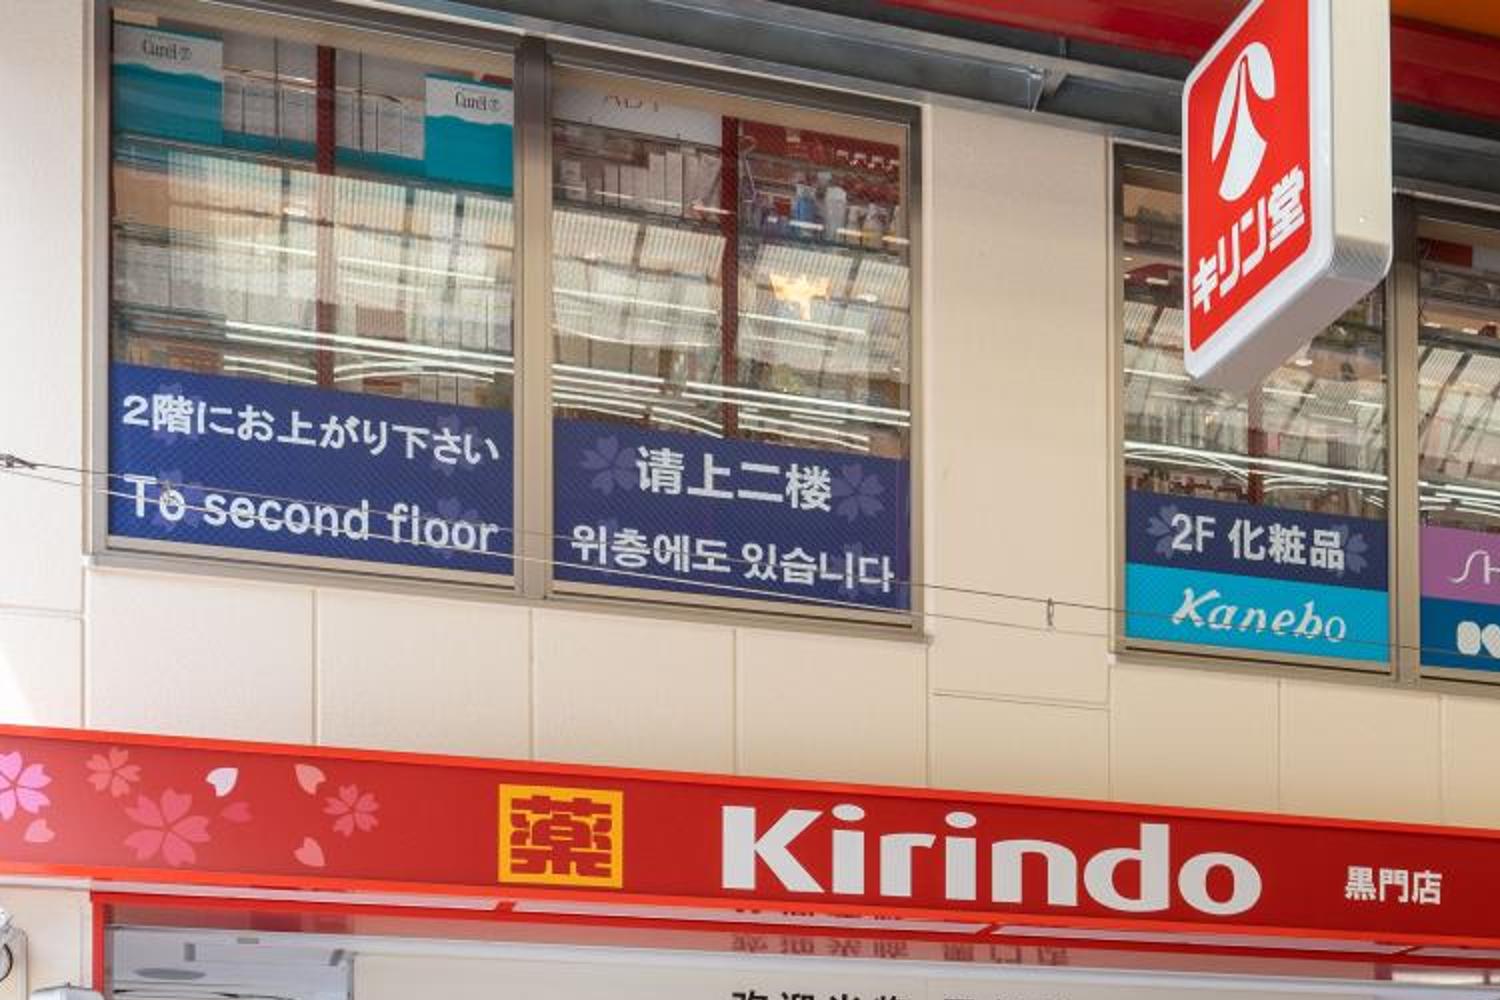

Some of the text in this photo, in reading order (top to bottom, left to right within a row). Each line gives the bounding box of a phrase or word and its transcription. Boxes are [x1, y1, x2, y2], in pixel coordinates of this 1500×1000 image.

[1191, 164, 1306, 313] キリン堂
[122, 394, 500, 466] 2階にお上がり下さい
[122, 474, 500, 553] To second floor
[635, 446, 833, 513] 请上二楼
[570, 524, 896, 593] 위층에도 있습니다
[1171, 513, 1347, 571] 2F 化粧品
[1171, 587, 1347, 643] Kanebo
[720, 803, 1264, 917] Kirindo
[1344, 865, 1443, 906] 黒門店
